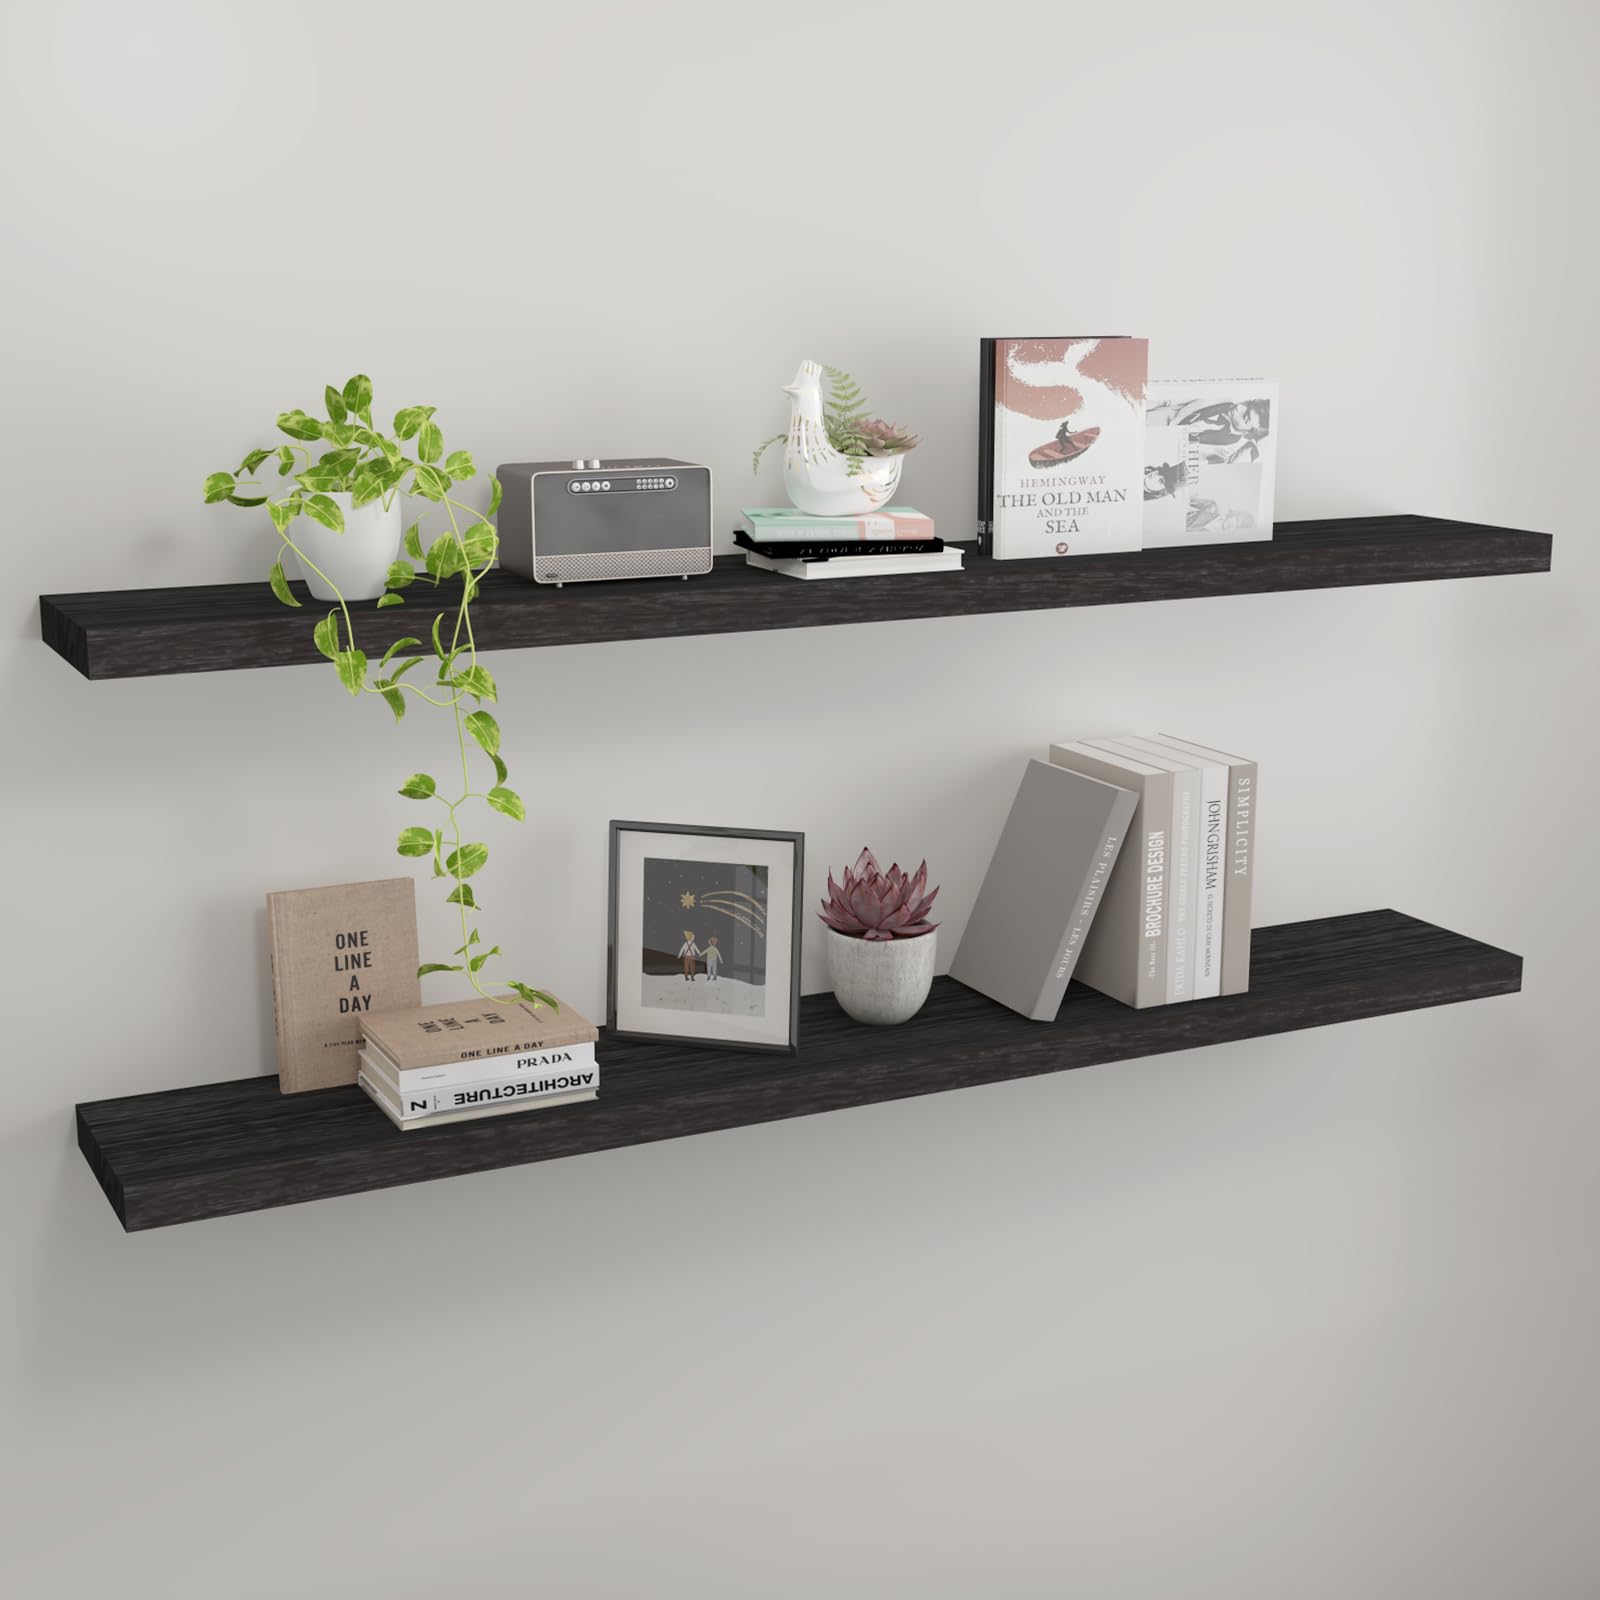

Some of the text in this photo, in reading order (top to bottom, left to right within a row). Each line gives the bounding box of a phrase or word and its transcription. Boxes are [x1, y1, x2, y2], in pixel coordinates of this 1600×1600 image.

[1020, 475, 1107, 488] HEMINGWAY
[997, 488, 1127, 508] THE OLD MAN
[1037, 507, 1088, 518] AND THE
[1045, 519, 1080, 534] SEA
[1234, 777, 1250, 876] SIMPLICITY
[1104, 836, 1117, 858] LES
[1147, 831, 1165, 873] DESIGN
[1081, 862, 1107, 917] PLAISIRS
[1145, 875, 1163, 938] BROCHURE
[335, 930, 369, 950] ONE
[334, 951, 373, 972] LINE
[349, 975, 360, 991] A
[339, 994, 371, 1013] DAY
[460, 1041, 545, 1059] ONE LINE A DAY
[517, 1052, 573, 1069] PRADA
[454, 1072, 594, 1105] ARCHITECTURE
